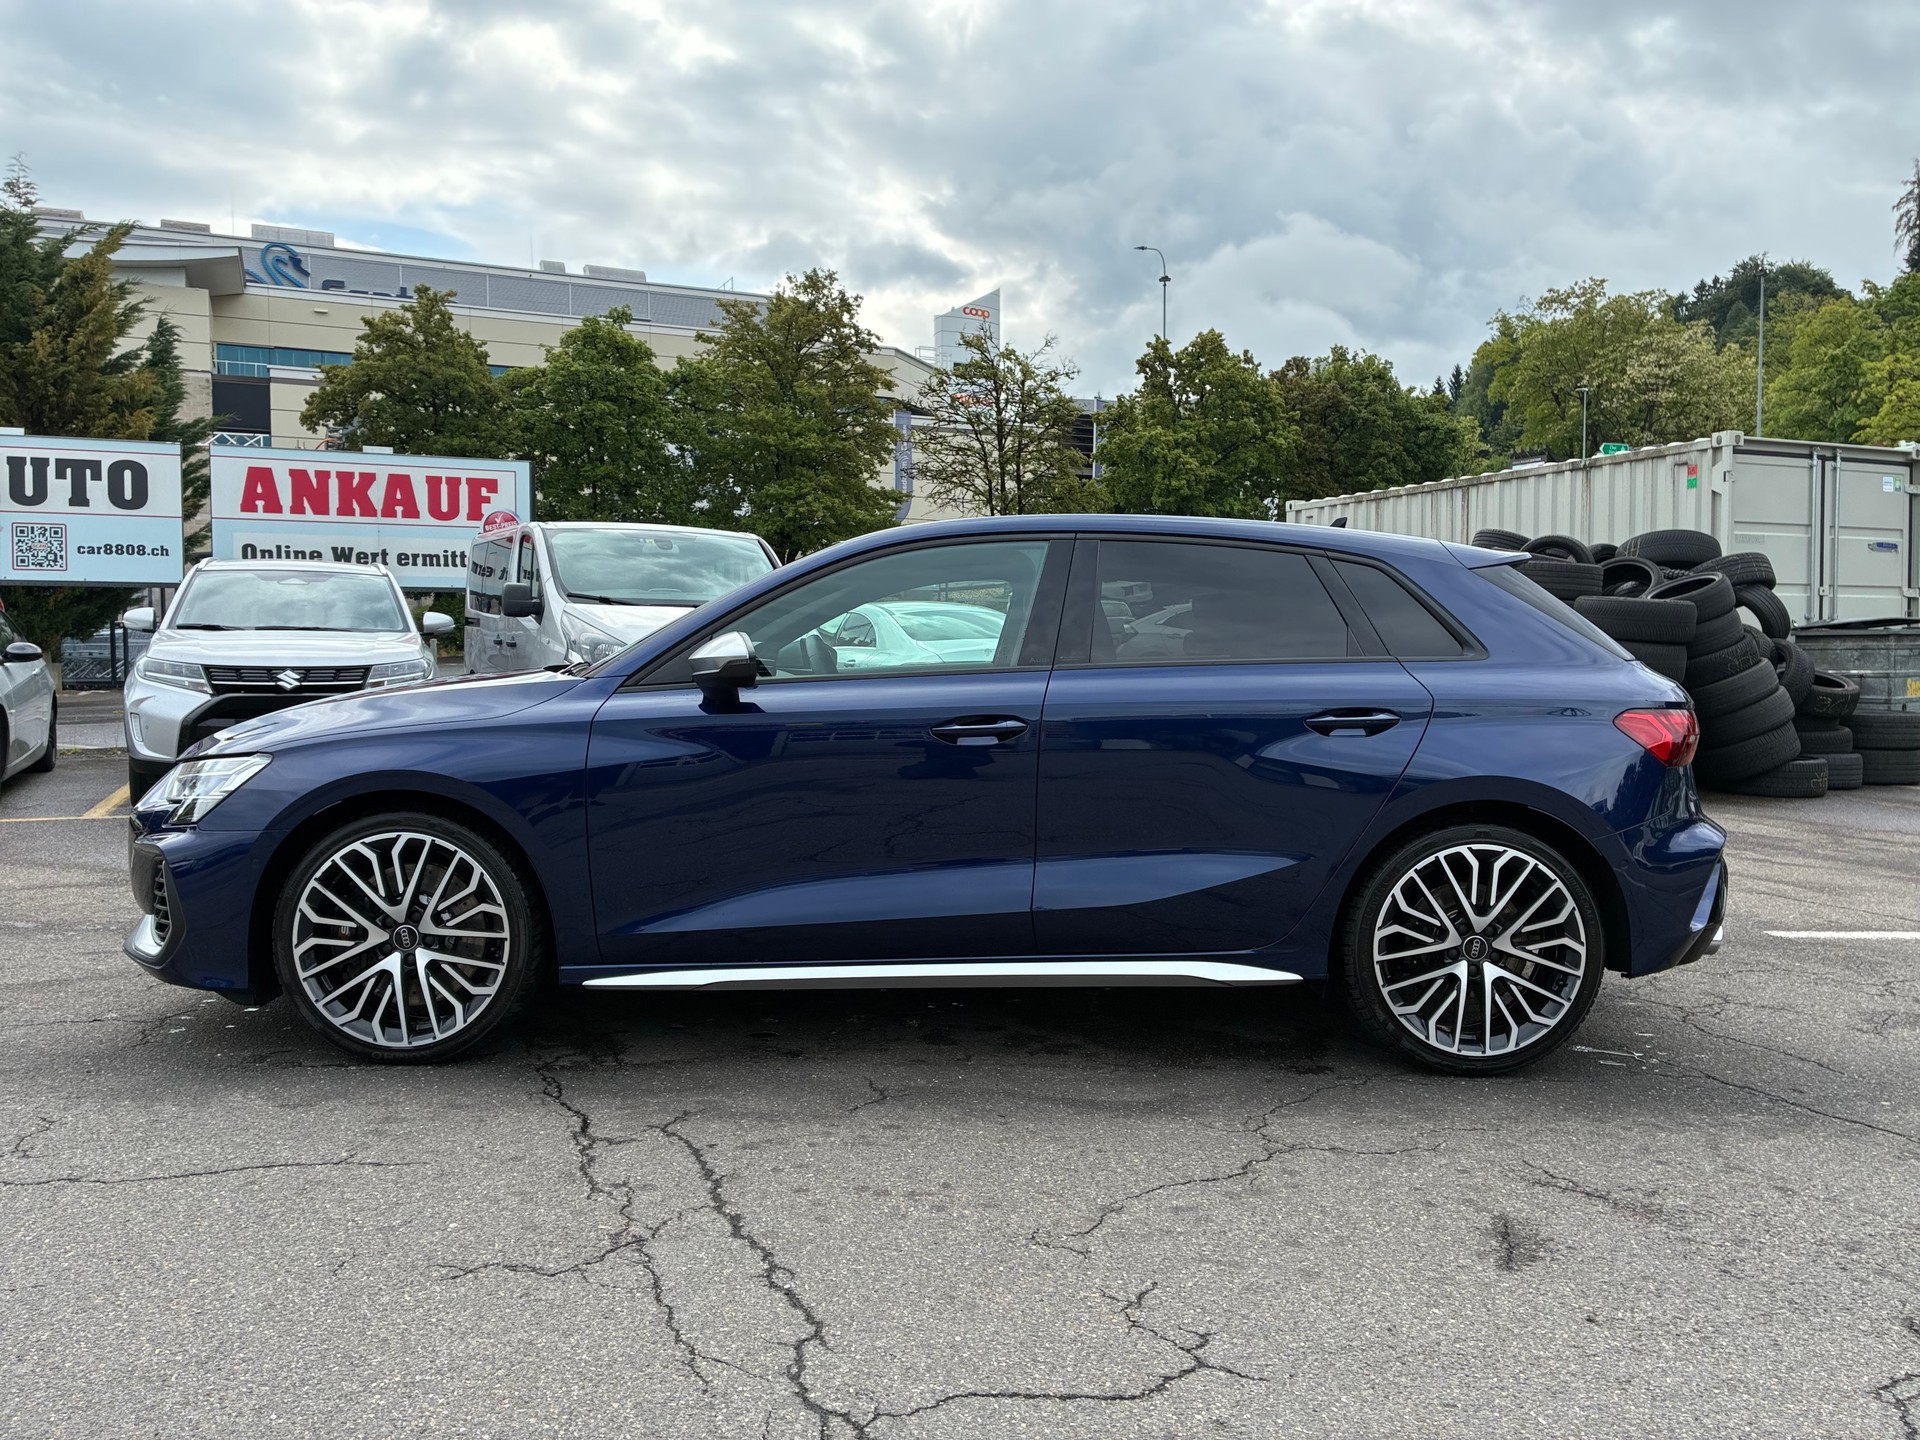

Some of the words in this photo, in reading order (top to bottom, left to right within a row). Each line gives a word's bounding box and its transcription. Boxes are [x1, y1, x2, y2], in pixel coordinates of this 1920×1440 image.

[963, 307, 990, 320] coop
[6, 456, 149, 510] UTO
[240, 466, 498, 521] ANKAUF
[77, 543, 170, 557] car8808.ch
[241, 543, 323, 560] Online
[331, 547, 389, 566] Wert
